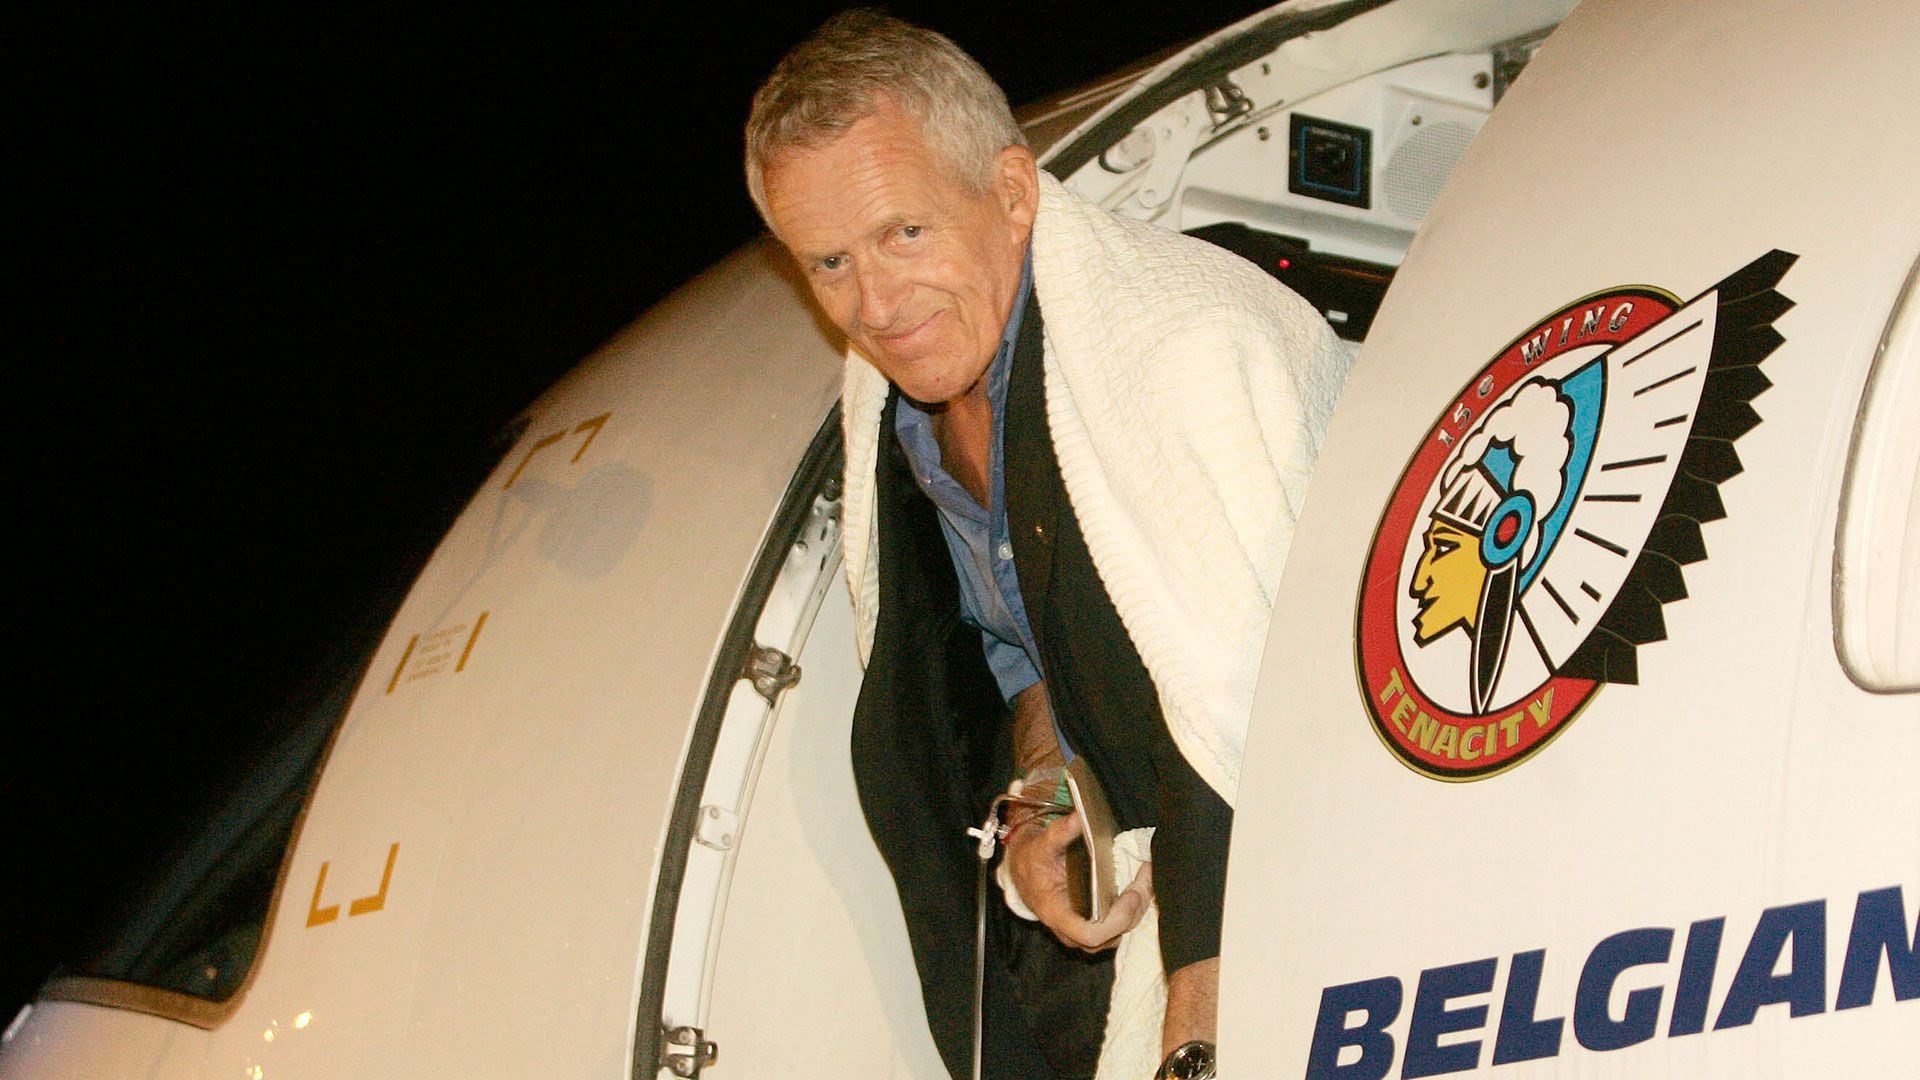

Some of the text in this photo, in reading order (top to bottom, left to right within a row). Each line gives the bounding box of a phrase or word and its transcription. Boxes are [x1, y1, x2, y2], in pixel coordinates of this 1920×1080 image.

[1520, 302, 1634, 366] WING
[1379, 667, 1554, 761] TENACITY
[1305, 884, 1920, 1080] BELGIAN
